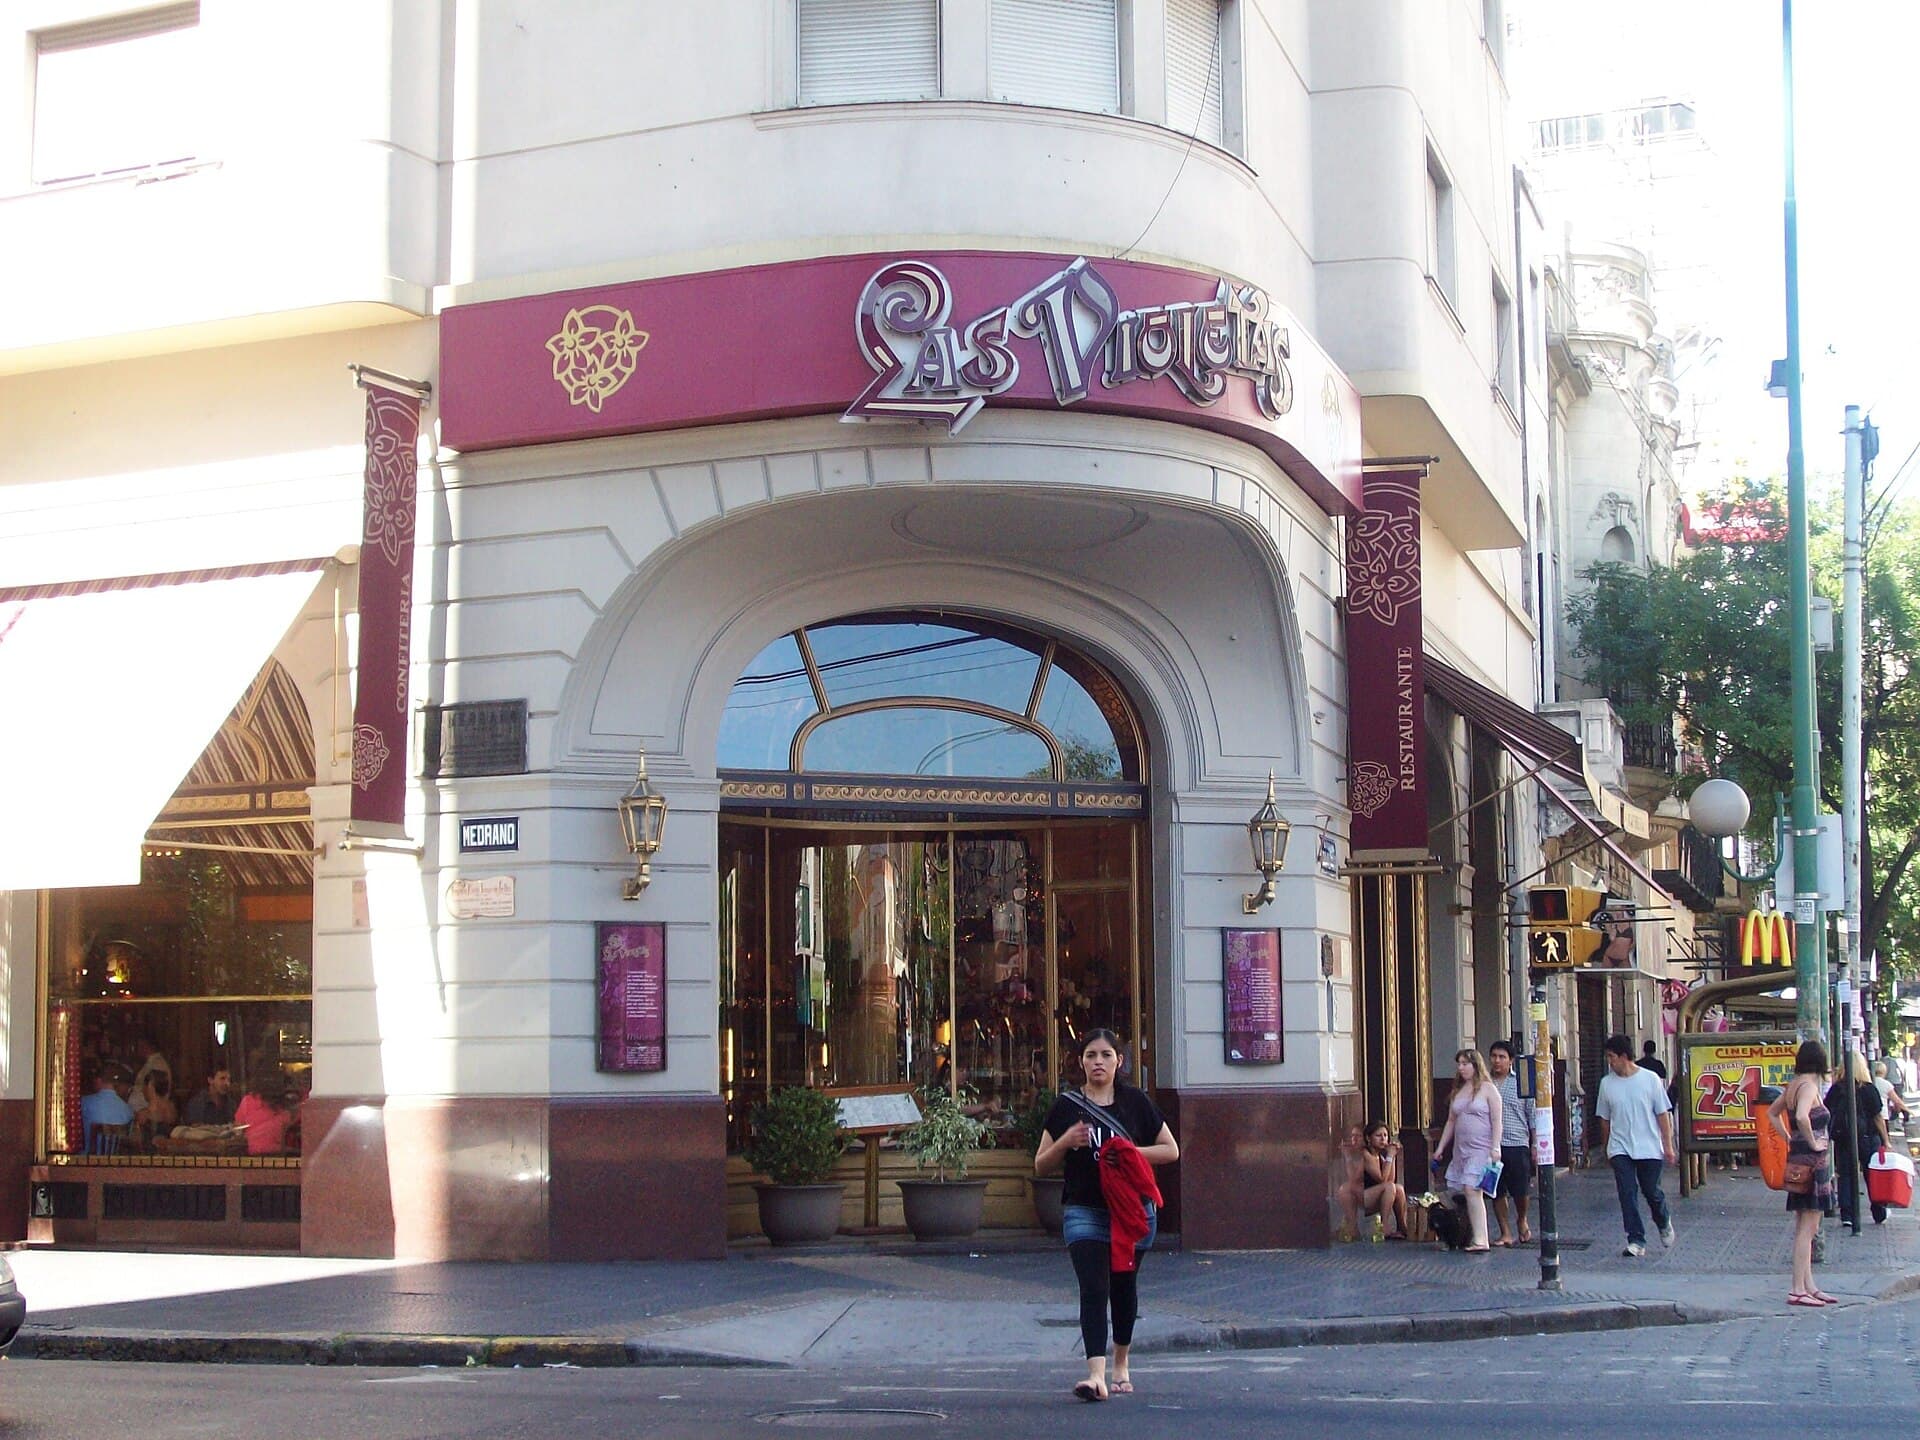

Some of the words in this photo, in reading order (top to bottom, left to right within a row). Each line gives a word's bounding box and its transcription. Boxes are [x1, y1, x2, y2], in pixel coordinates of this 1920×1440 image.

[396, 572, 412, 713] CONFITERIA
[1397, 646, 1416, 791] RESTAURANTE
[462, 823, 515, 847] MEDRANO
